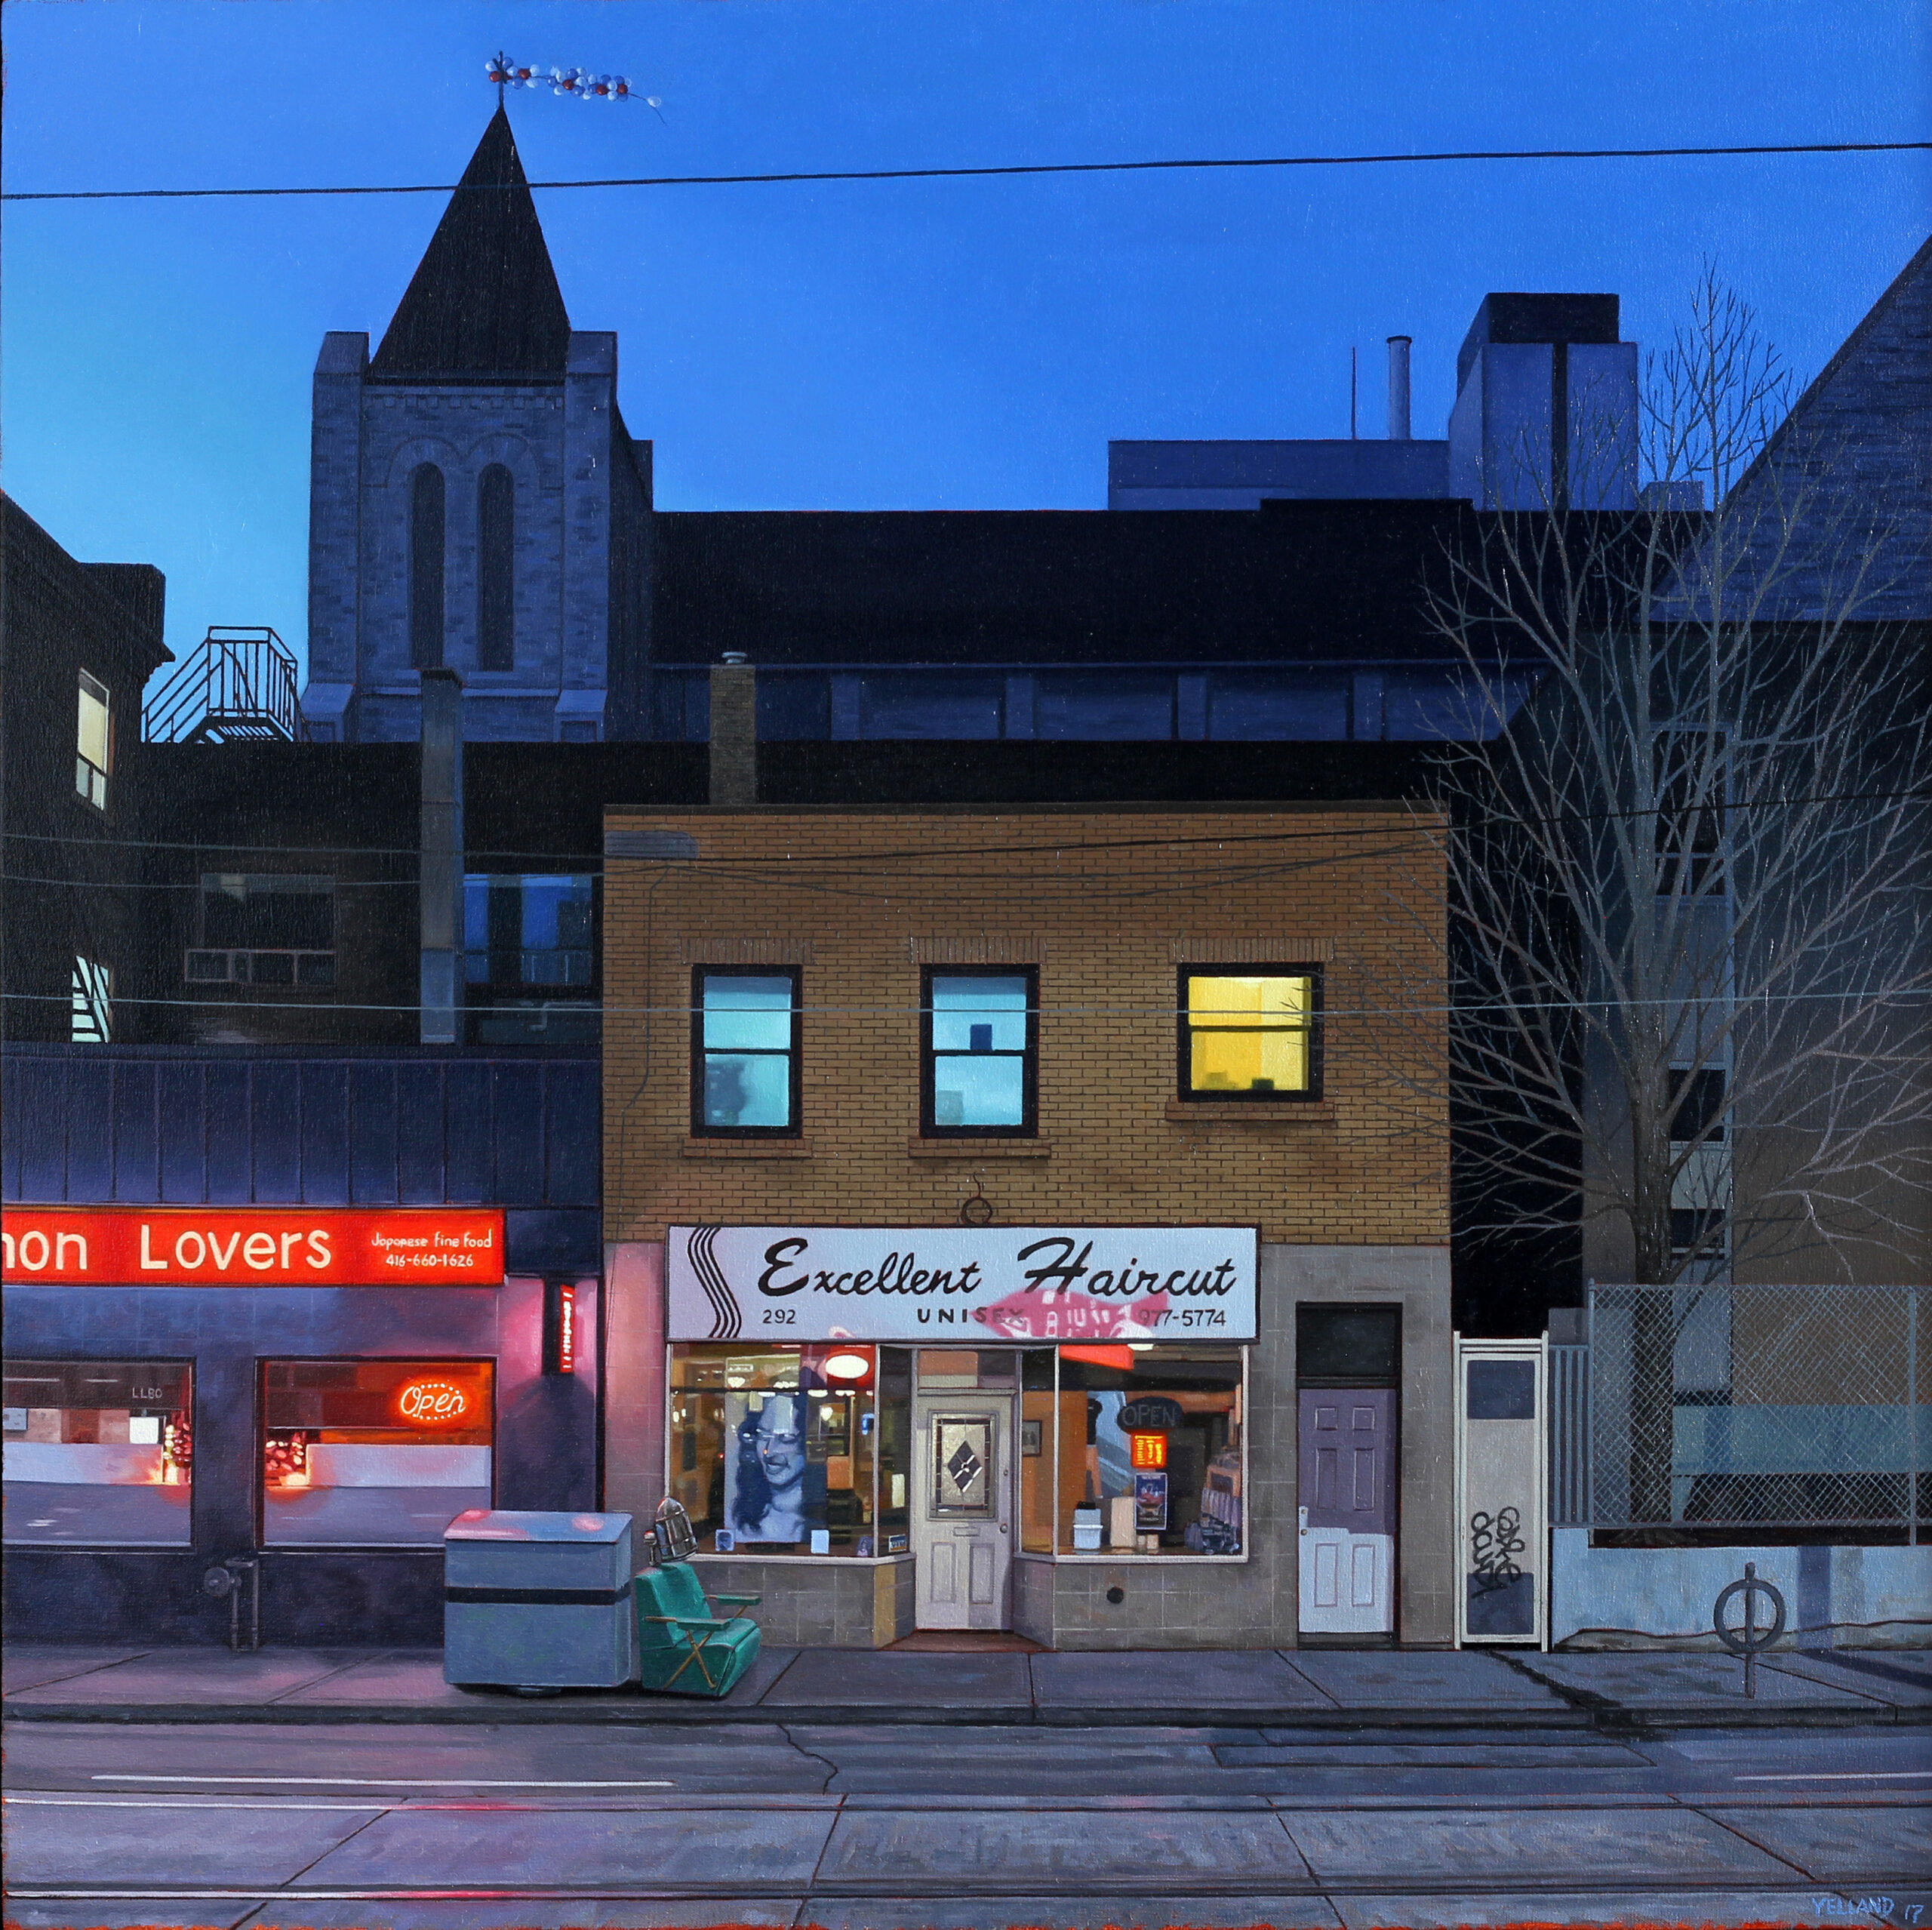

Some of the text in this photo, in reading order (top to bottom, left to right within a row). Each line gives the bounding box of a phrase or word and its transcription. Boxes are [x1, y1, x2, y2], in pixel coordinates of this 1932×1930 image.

[140, 1224, 331, 1270] Lovers
[386, 1254, 474, 1267] 416-660-1626
[758, 1236, 1237, 1296] Excellent Haircut
[762, 1309, 796, 1324] 292
[918, 1307, 1024, 1324] UNISEX
[1138, 1309, 1226, 1327] 977-5774
[132, 1387, 163, 1399] LLBO
[401, 1386, 466, 1417] Open
[1122, 1404, 1175, 1427] OPEN
[1812, 1896, 1895, 1918] YELLAND
